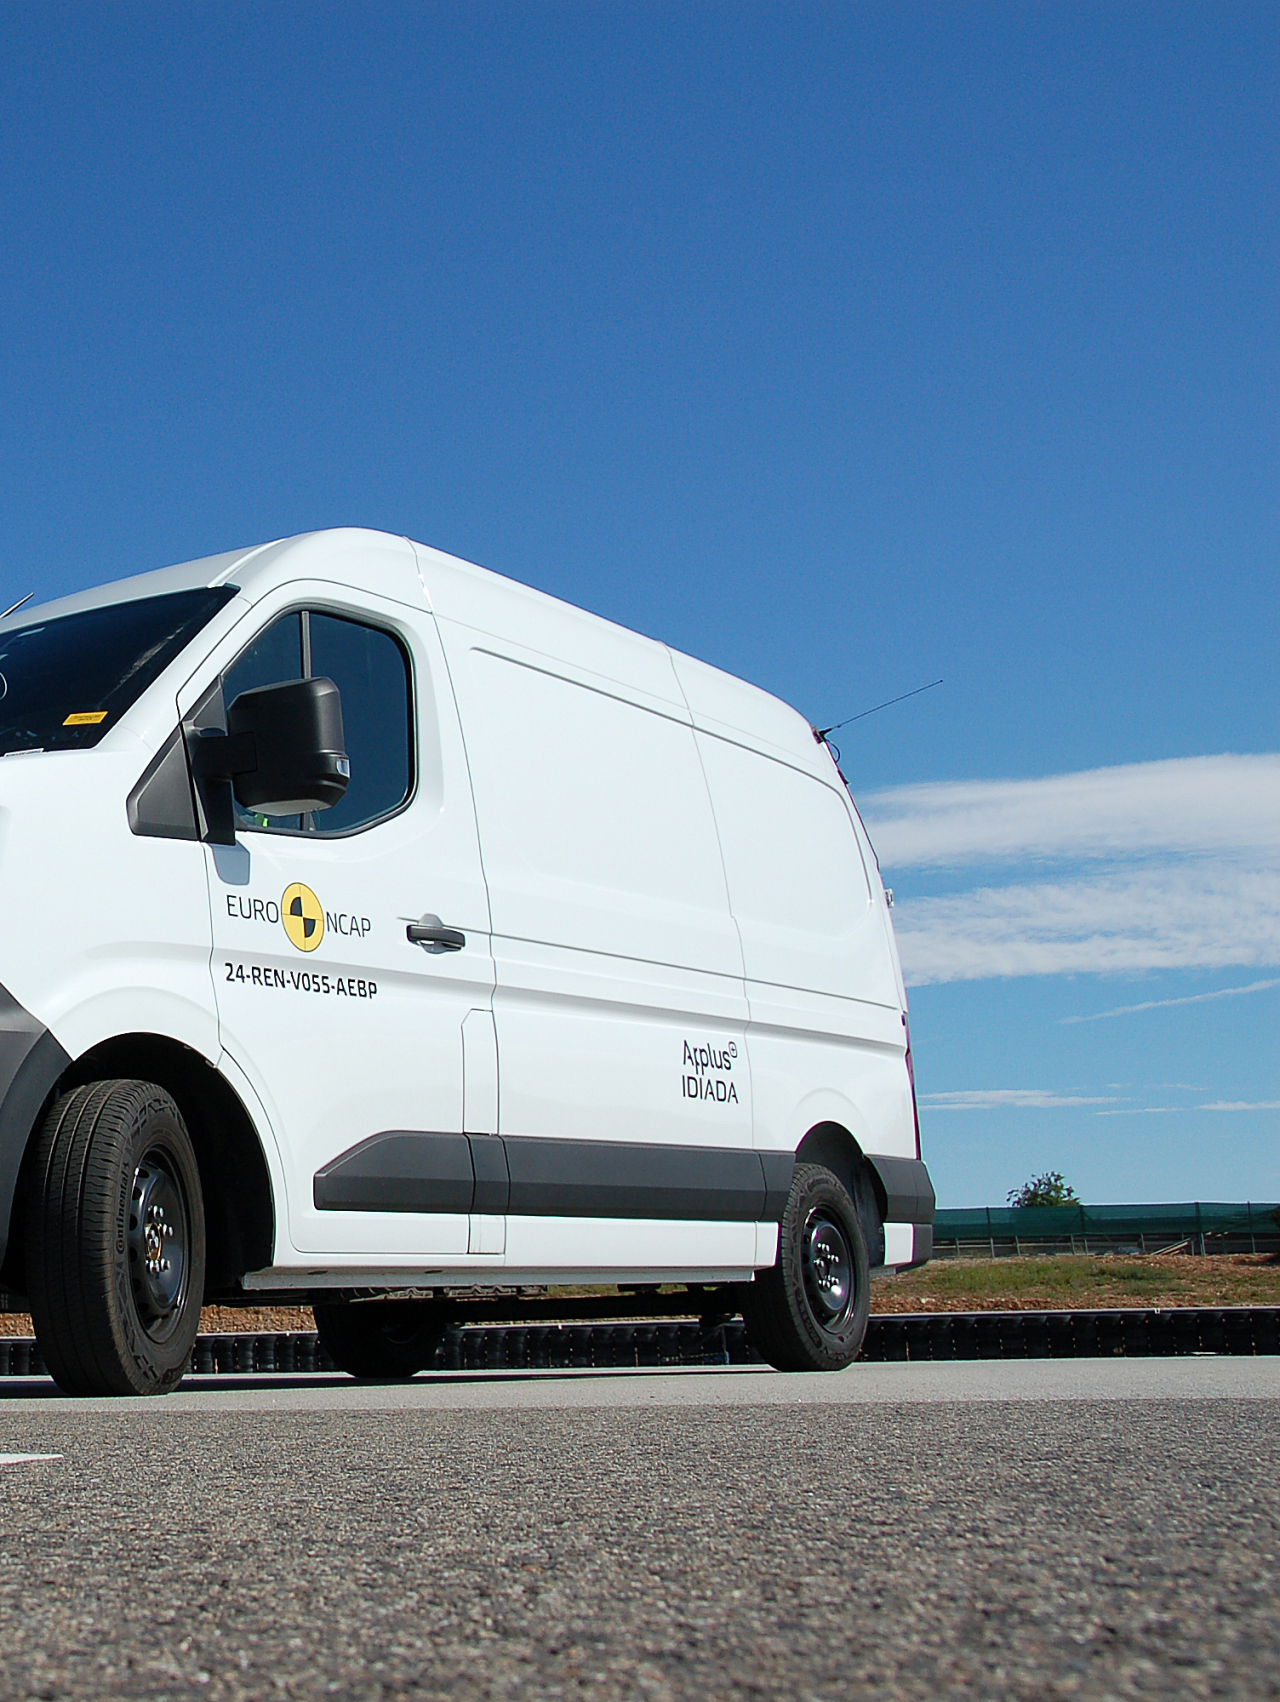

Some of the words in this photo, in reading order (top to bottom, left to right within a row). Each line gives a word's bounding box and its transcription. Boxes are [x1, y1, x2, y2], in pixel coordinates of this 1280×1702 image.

[227, 895, 279, 924] EURO
[327, 912, 371, 938] NCAP
[225, 963, 378, 999] 24-REN-V055-AEBP
[682, 1075, 739, 1104] IDIADA
[116, 1170, 128, 1255] Continental
